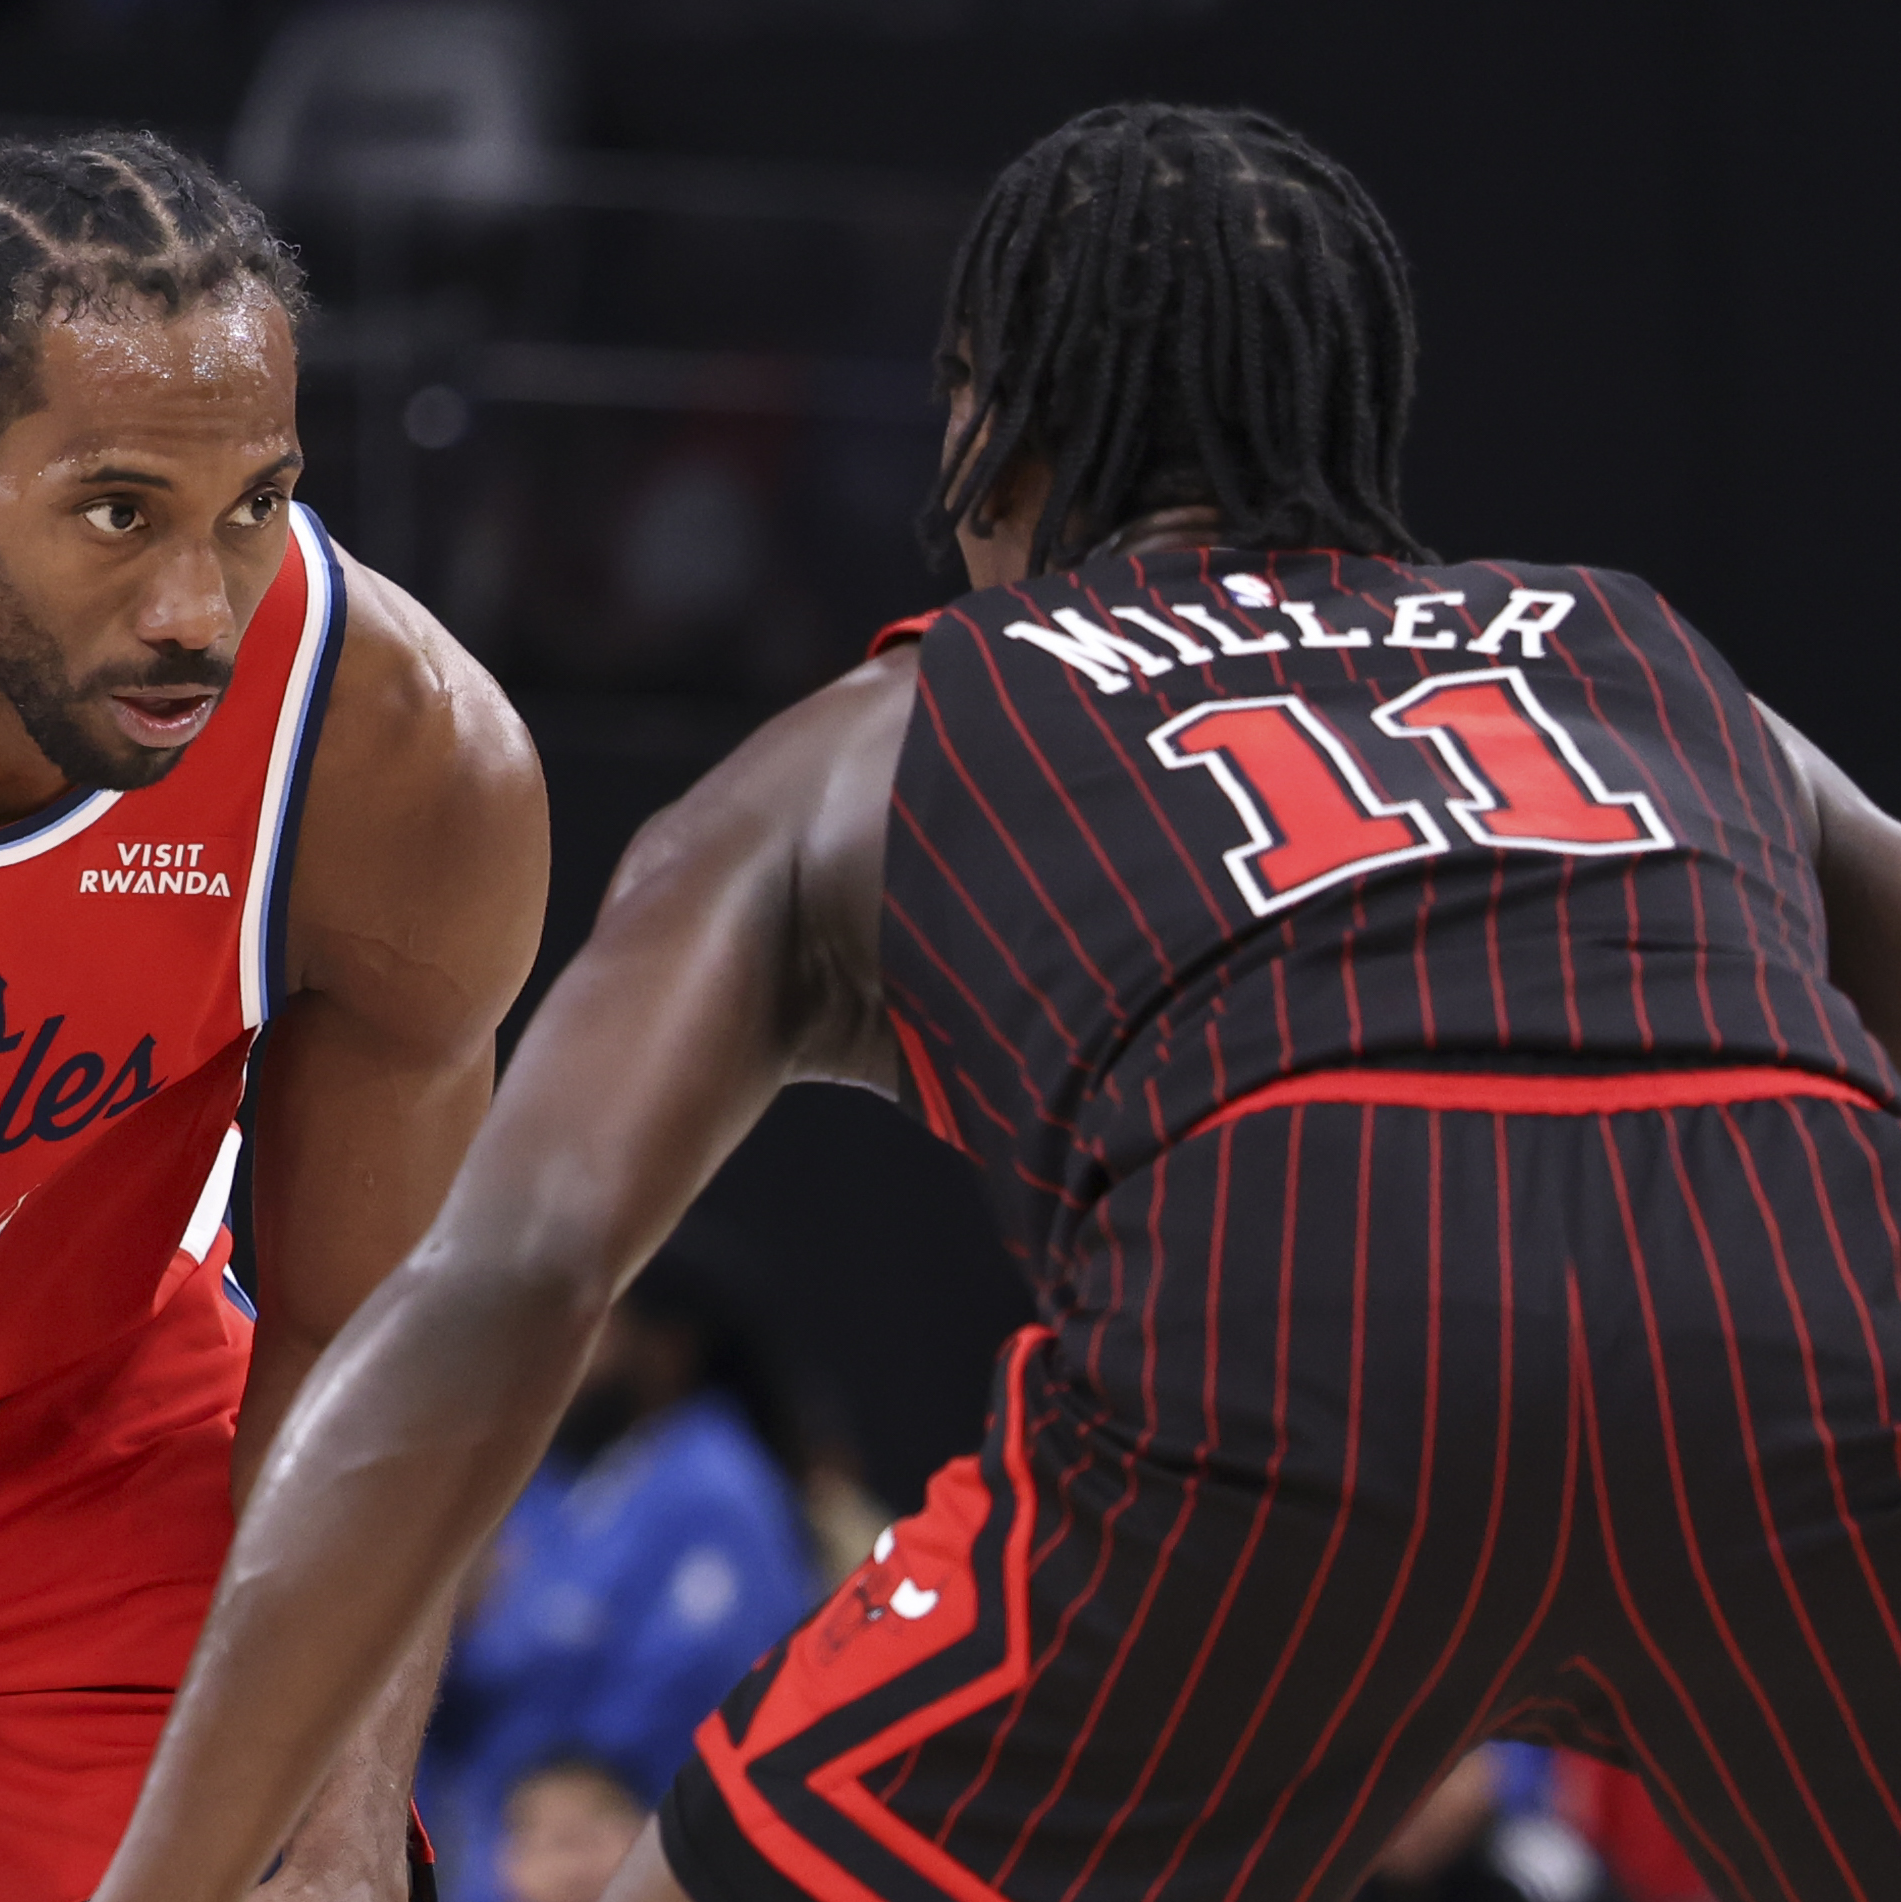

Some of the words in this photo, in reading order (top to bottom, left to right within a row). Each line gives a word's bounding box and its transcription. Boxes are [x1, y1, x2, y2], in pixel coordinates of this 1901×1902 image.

[1003, 586, 1576, 695] MILLER
[1146, 665, 1676, 917] 11
[79, 869, 231, 898] RWANDA
[116, 842, 204, 868] VISIT
